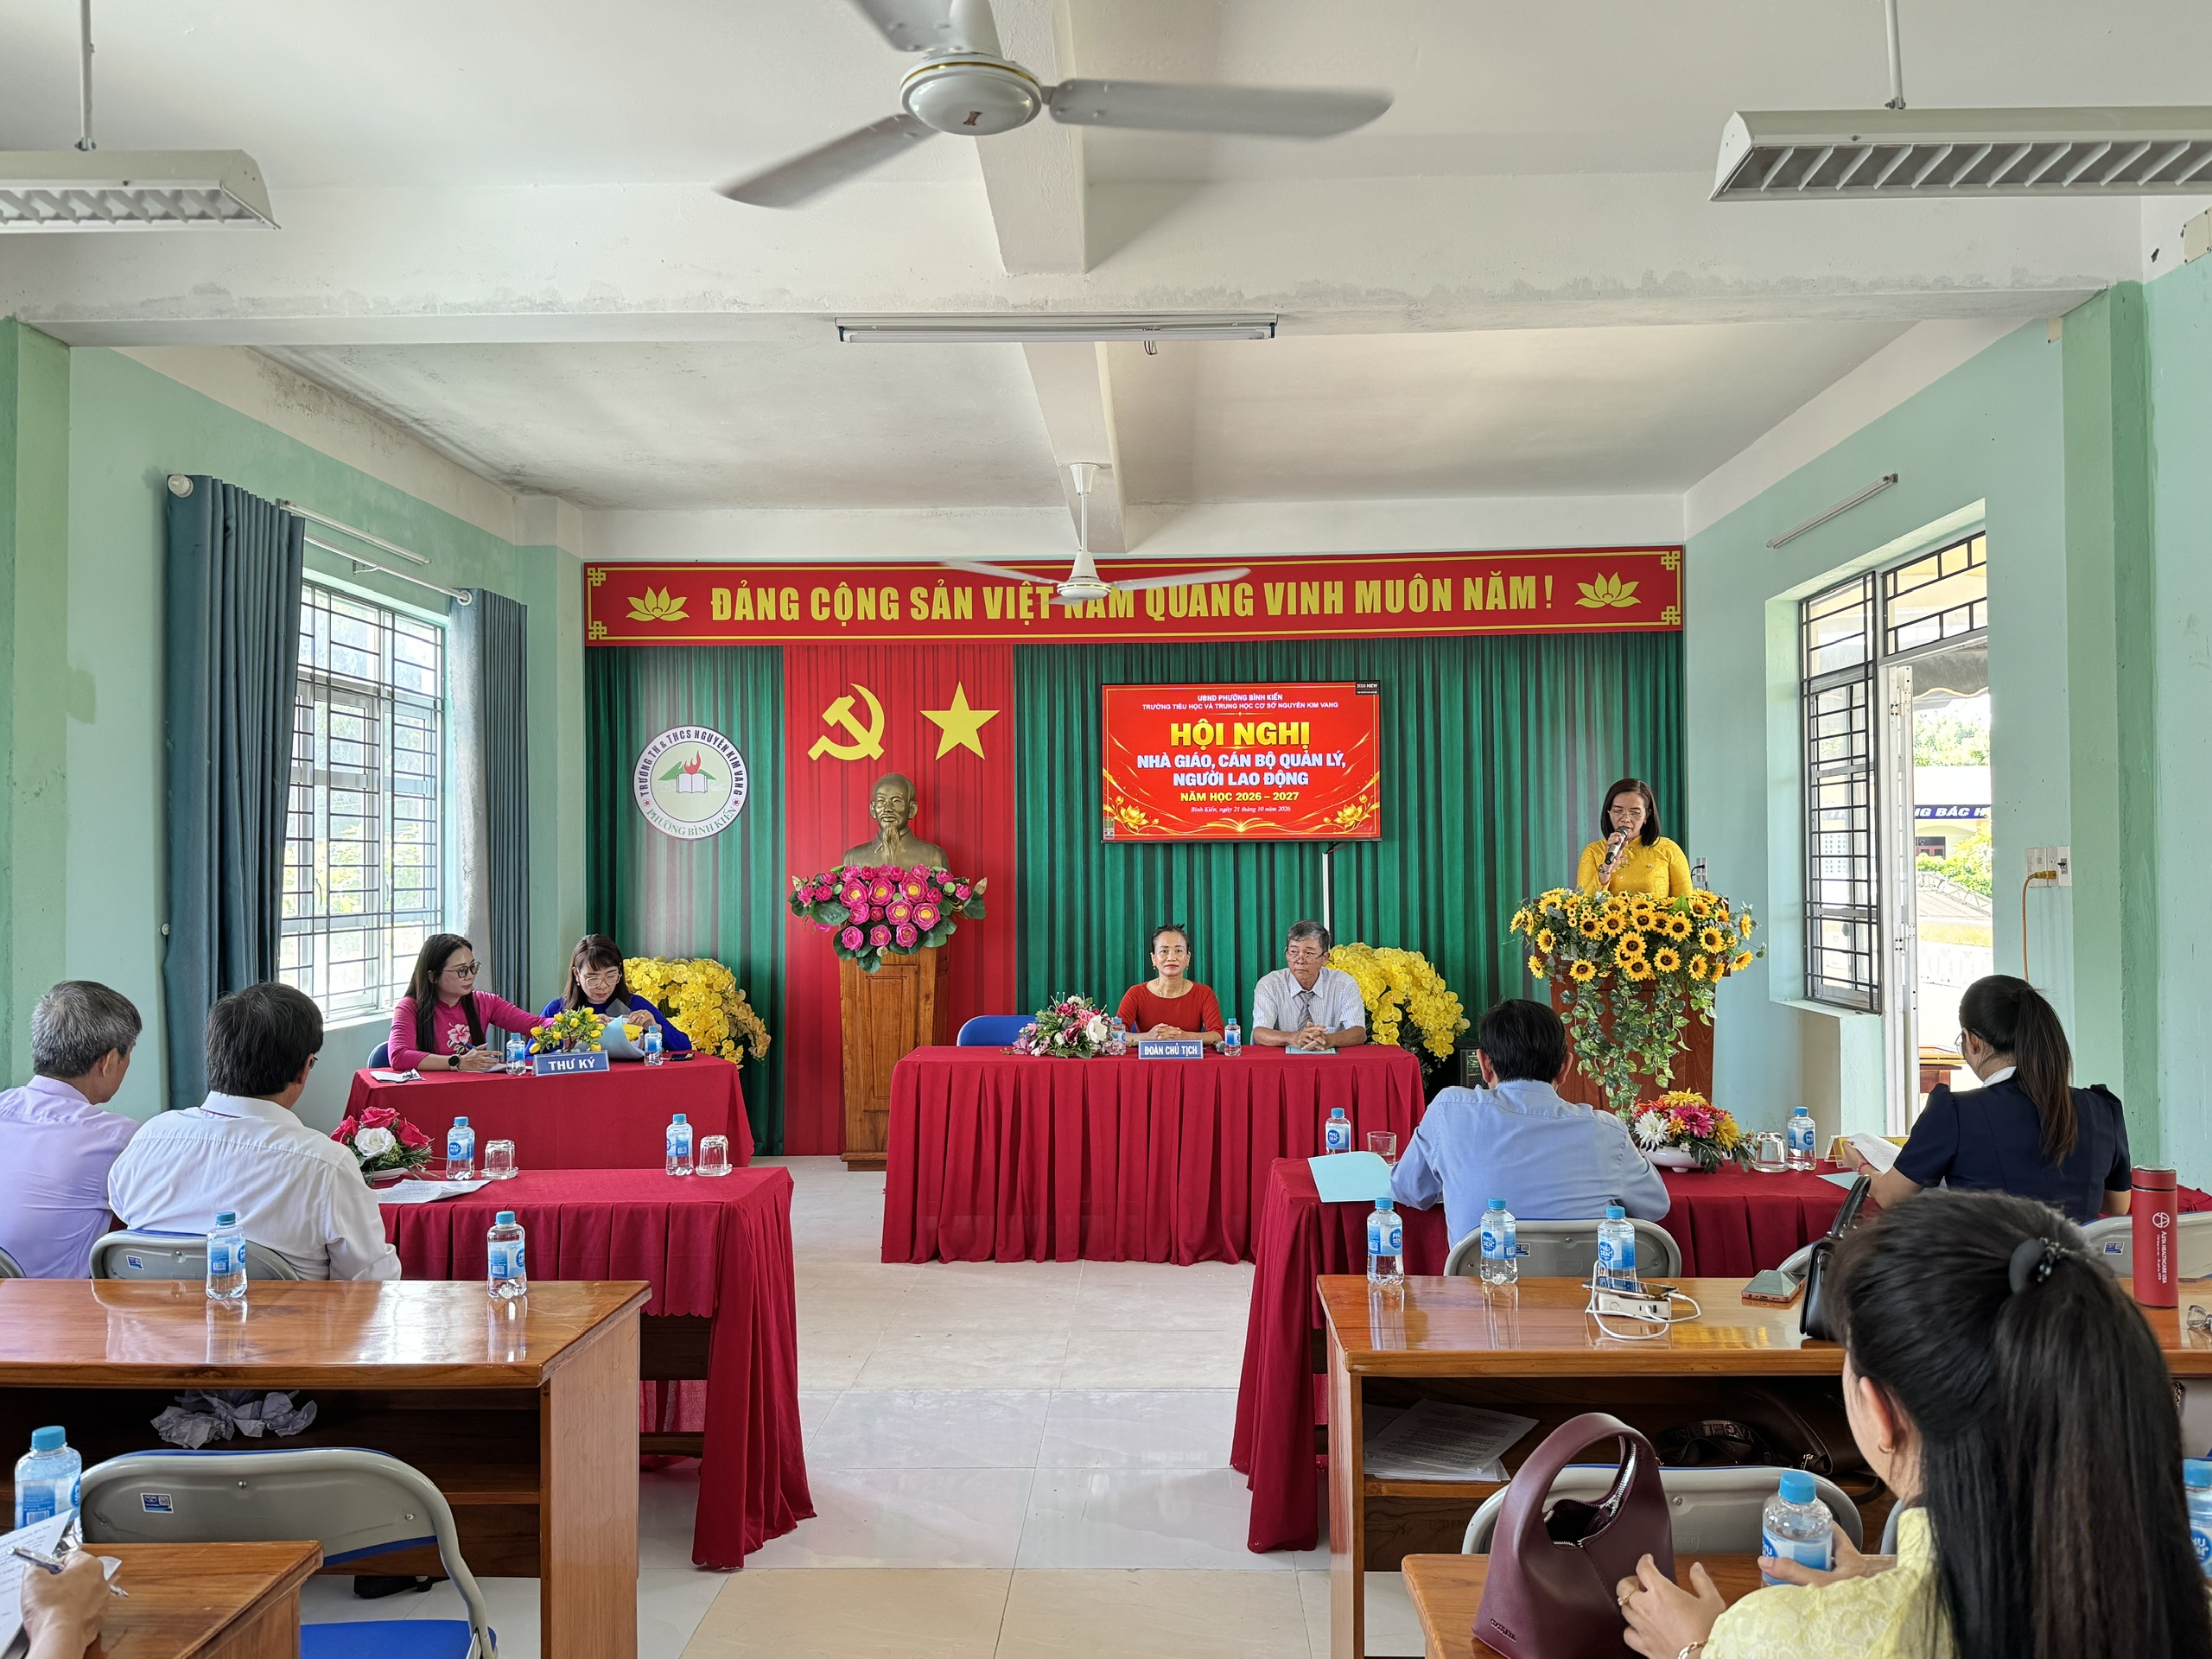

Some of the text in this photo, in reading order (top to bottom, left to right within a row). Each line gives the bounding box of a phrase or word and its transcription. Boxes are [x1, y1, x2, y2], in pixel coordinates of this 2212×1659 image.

[711, 579, 800, 621] ĐẢNG
[810, 581, 903, 627] CỘNG
[910, 578, 974, 621] SẢN
[984, 580, 1052, 626] VIỆT
[1145, 582, 1255, 621] QUANG
[1264, 579, 1344, 616] VINH
[1355, 572, 1453, 613] MUÔN
[1462, 569, 1536, 611] NĂM
[1249, 692, 1266, 701] BÌNH
[1267, 691, 1283, 701] KIẾN
[1188, 702, 1203, 711] HỌC
[666, 729, 691, 745] THCS
[1170, 718, 1310, 751] HỘI NGHỊ
[647, 745, 661, 759] TH
[661, 741, 667, 749] &
[726, 750, 741, 769] KIM
[1137, 750, 1346, 770] NHÀ GIÁO, CÁN BỘ QUẢN LÝ,
[639, 758, 652, 797] TRƯỜNG
[733, 770, 744, 797] VANG
[1173, 770, 1309, 789] NGƯỜI LAO ĐỘNG
[1180, 791, 1207, 802] NĂM
[1210, 791, 1233, 804] HỌC
[1235, 791, 1262, 802] 2026
[1273, 791, 1300, 802] 2027
[1935, 805, 1970, 817] BÁC
[646, 806, 737, 836] PHƯỜNG BÌNH KIẾN
[1144, 1042, 1198, 1058] ĐOÀN CHỦ TỊCH
[548, 1056, 596, 1071] THƯ KÝ
